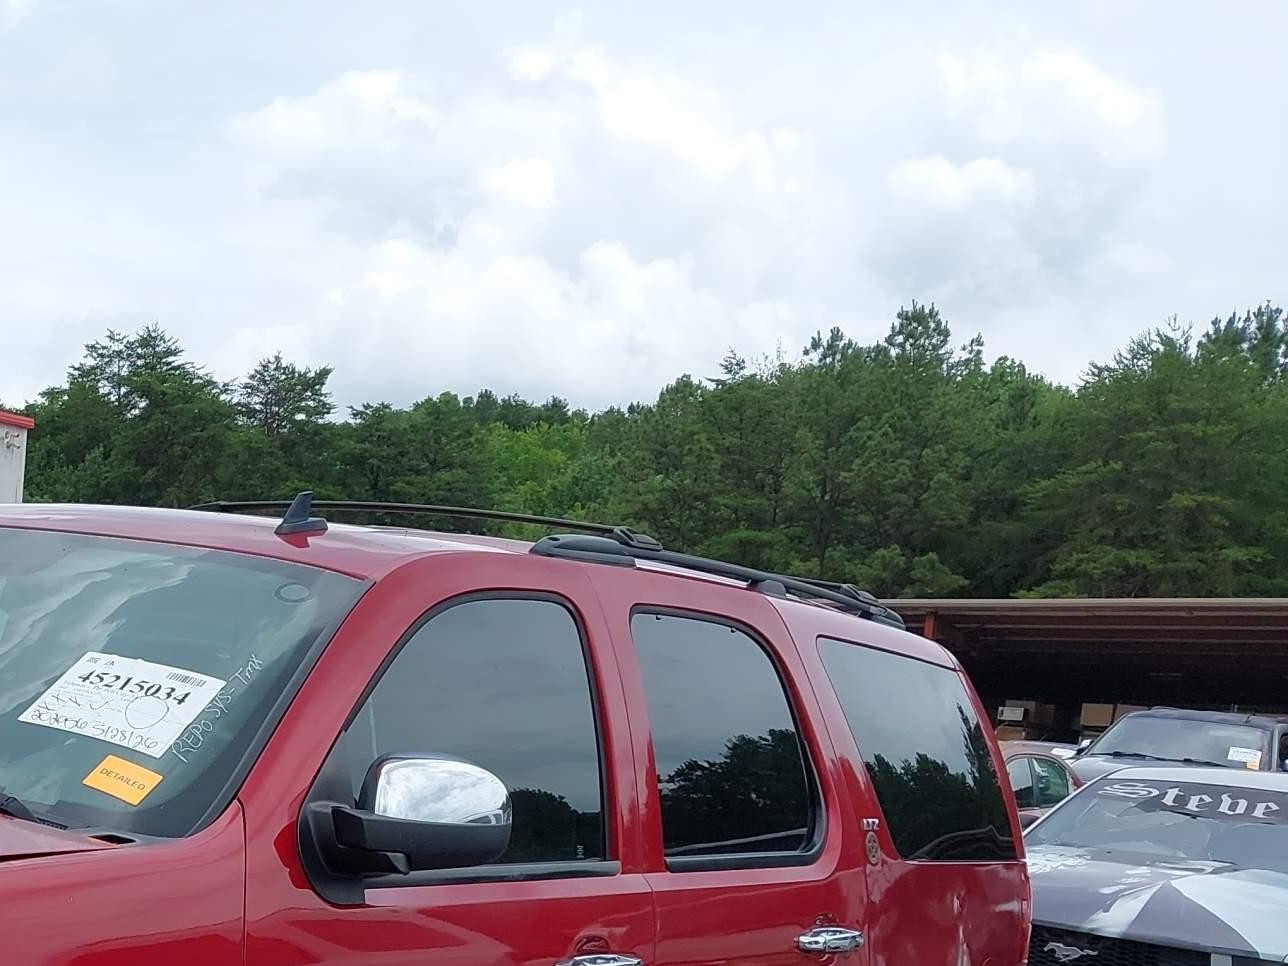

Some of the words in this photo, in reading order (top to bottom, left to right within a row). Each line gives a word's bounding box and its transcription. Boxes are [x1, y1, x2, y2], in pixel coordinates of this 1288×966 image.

[78, 669, 191, 706] 45215034
[99, 767, 146, 792] DETAILED
[1097, 782, 1281, 819] Steve
